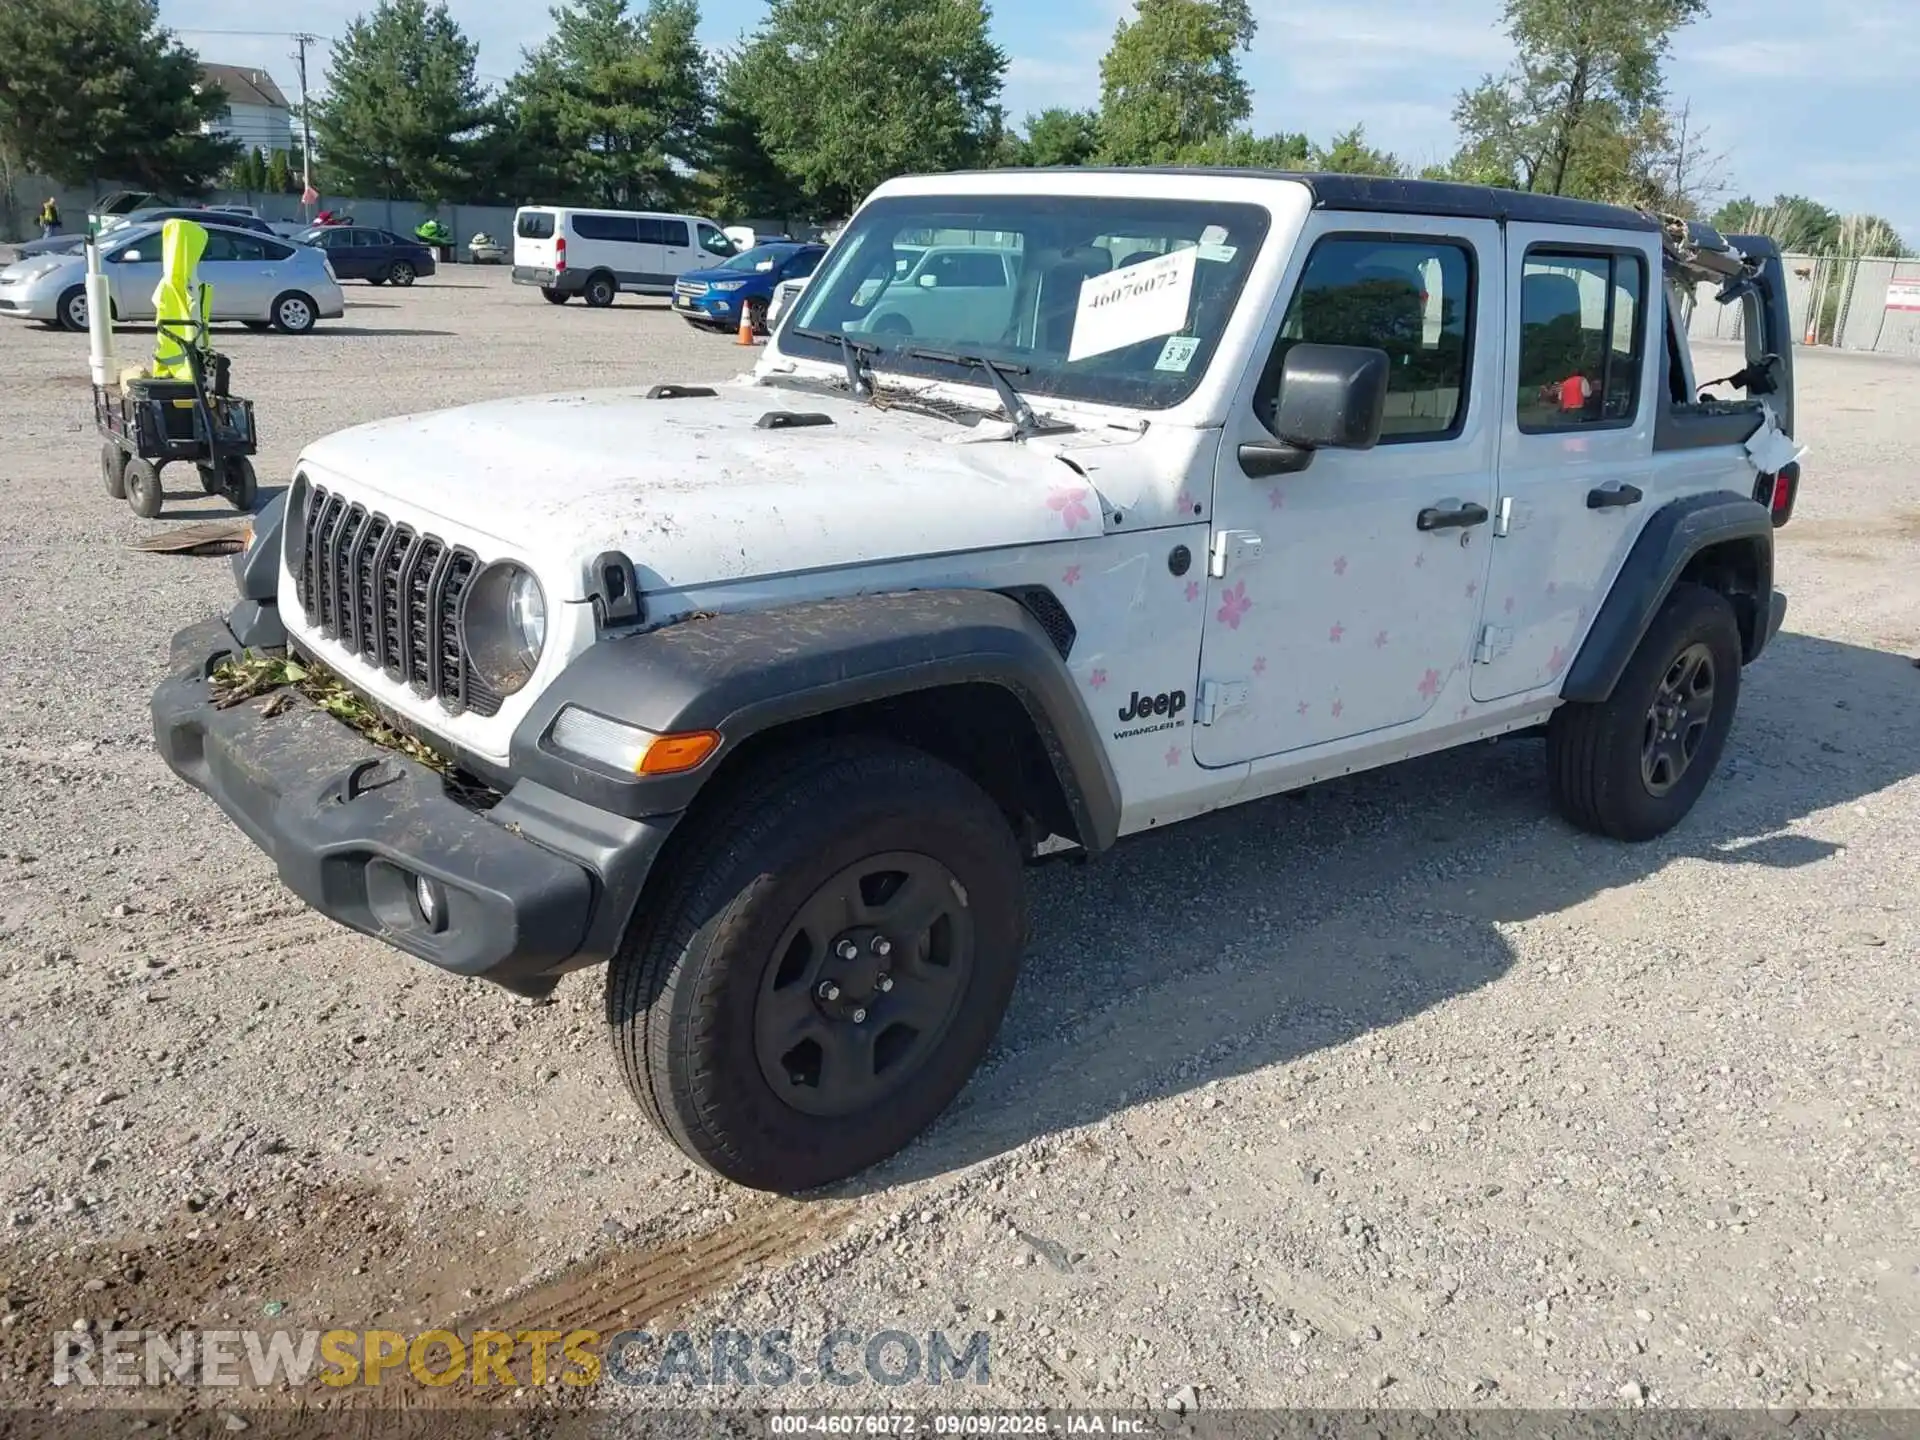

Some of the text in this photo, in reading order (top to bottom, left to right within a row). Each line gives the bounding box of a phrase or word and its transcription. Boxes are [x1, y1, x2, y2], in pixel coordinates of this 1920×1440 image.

[1088, 270, 1178, 309] 46076072
[1118, 690, 1186, 722] Jeep
[1113, 721, 1174, 740] WRANGLER
